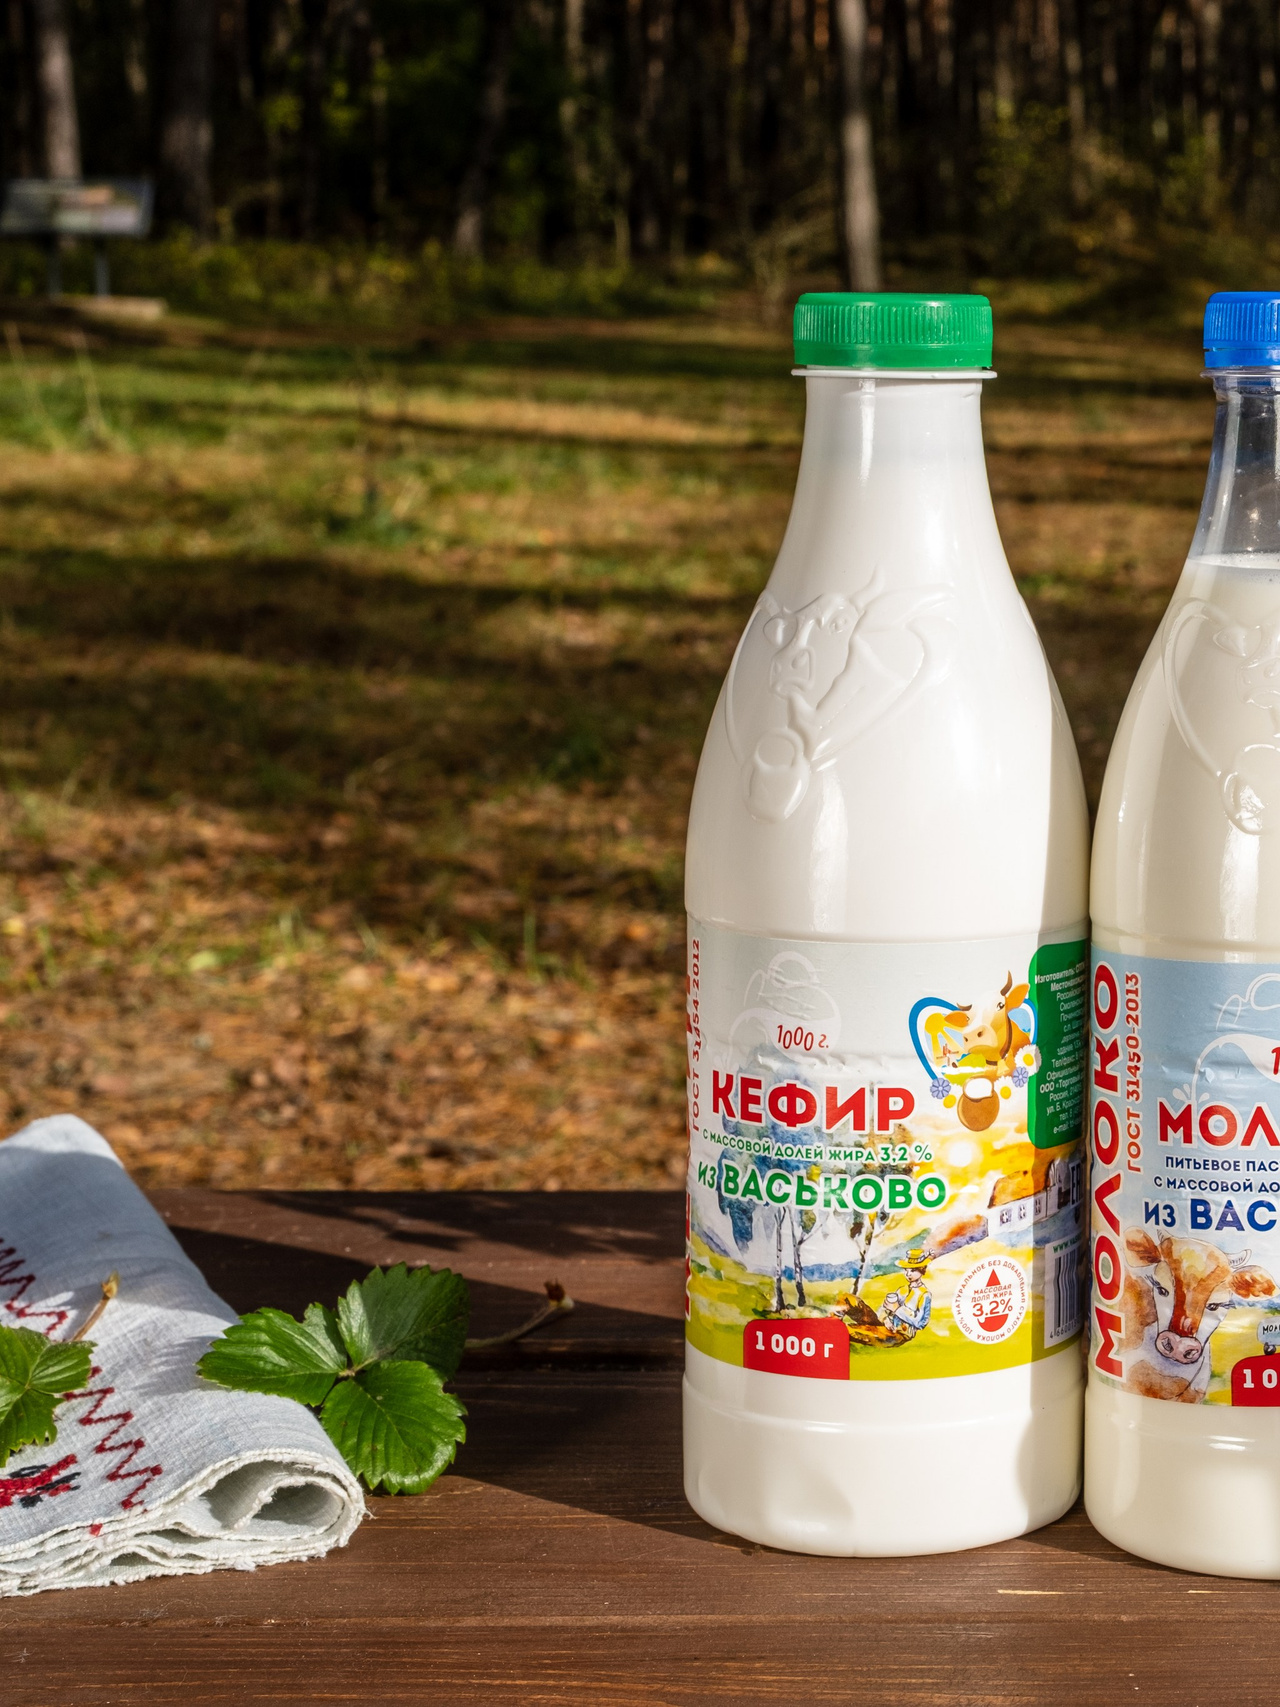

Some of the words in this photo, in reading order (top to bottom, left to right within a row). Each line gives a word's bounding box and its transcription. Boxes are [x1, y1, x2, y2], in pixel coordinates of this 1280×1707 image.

[692, 938, 701, 1062] 31454-2012
[777, 1024, 814, 1051] 1000
[1125, 973, 1142, 1102] 31450-2013
[712, 1069, 915, 1131] КЕФИР
[1040, 1082, 1055, 1093] ООО
[702, 1128, 709, 1139] С
[710, 1133, 771, 1155] МАССОВОЙ
[774, 1145, 823, 1160] ДОЛЕЙ
[828, 1149, 876, 1162] ЖИРА
[880, 1146, 908, 1163] 3,2
[914, 1144, 933, 1161] %
[1127, 1107, 1141, 1173] ГОСТ
[1094, 964, 1123, 1378] МОЛОКО
[1165, 1156, 1241, 1172] ПИТЬЕВОЕ
[723, 1163, 946, 1210] ВАСЬКОВО
[1154, 1176, 1163, 1187] С
[1166, 1176, 1254, 1193] МАССОВОЙ
[955, 1263, 986, 1315] НАТУРАЛЬНОЕ
[988, 1259, 1001, 1267] БЕЗ
[1006, 1306, 1025, 1334] СУХОГО
[973, 1283, 1012, 1295] МАССОВАЯ
[992, 1290, 1013, 1299] ЖИРА
[972, 1297, 1013, 1317] 3.2%
[1243, 1369, 1254, 1388] 1
